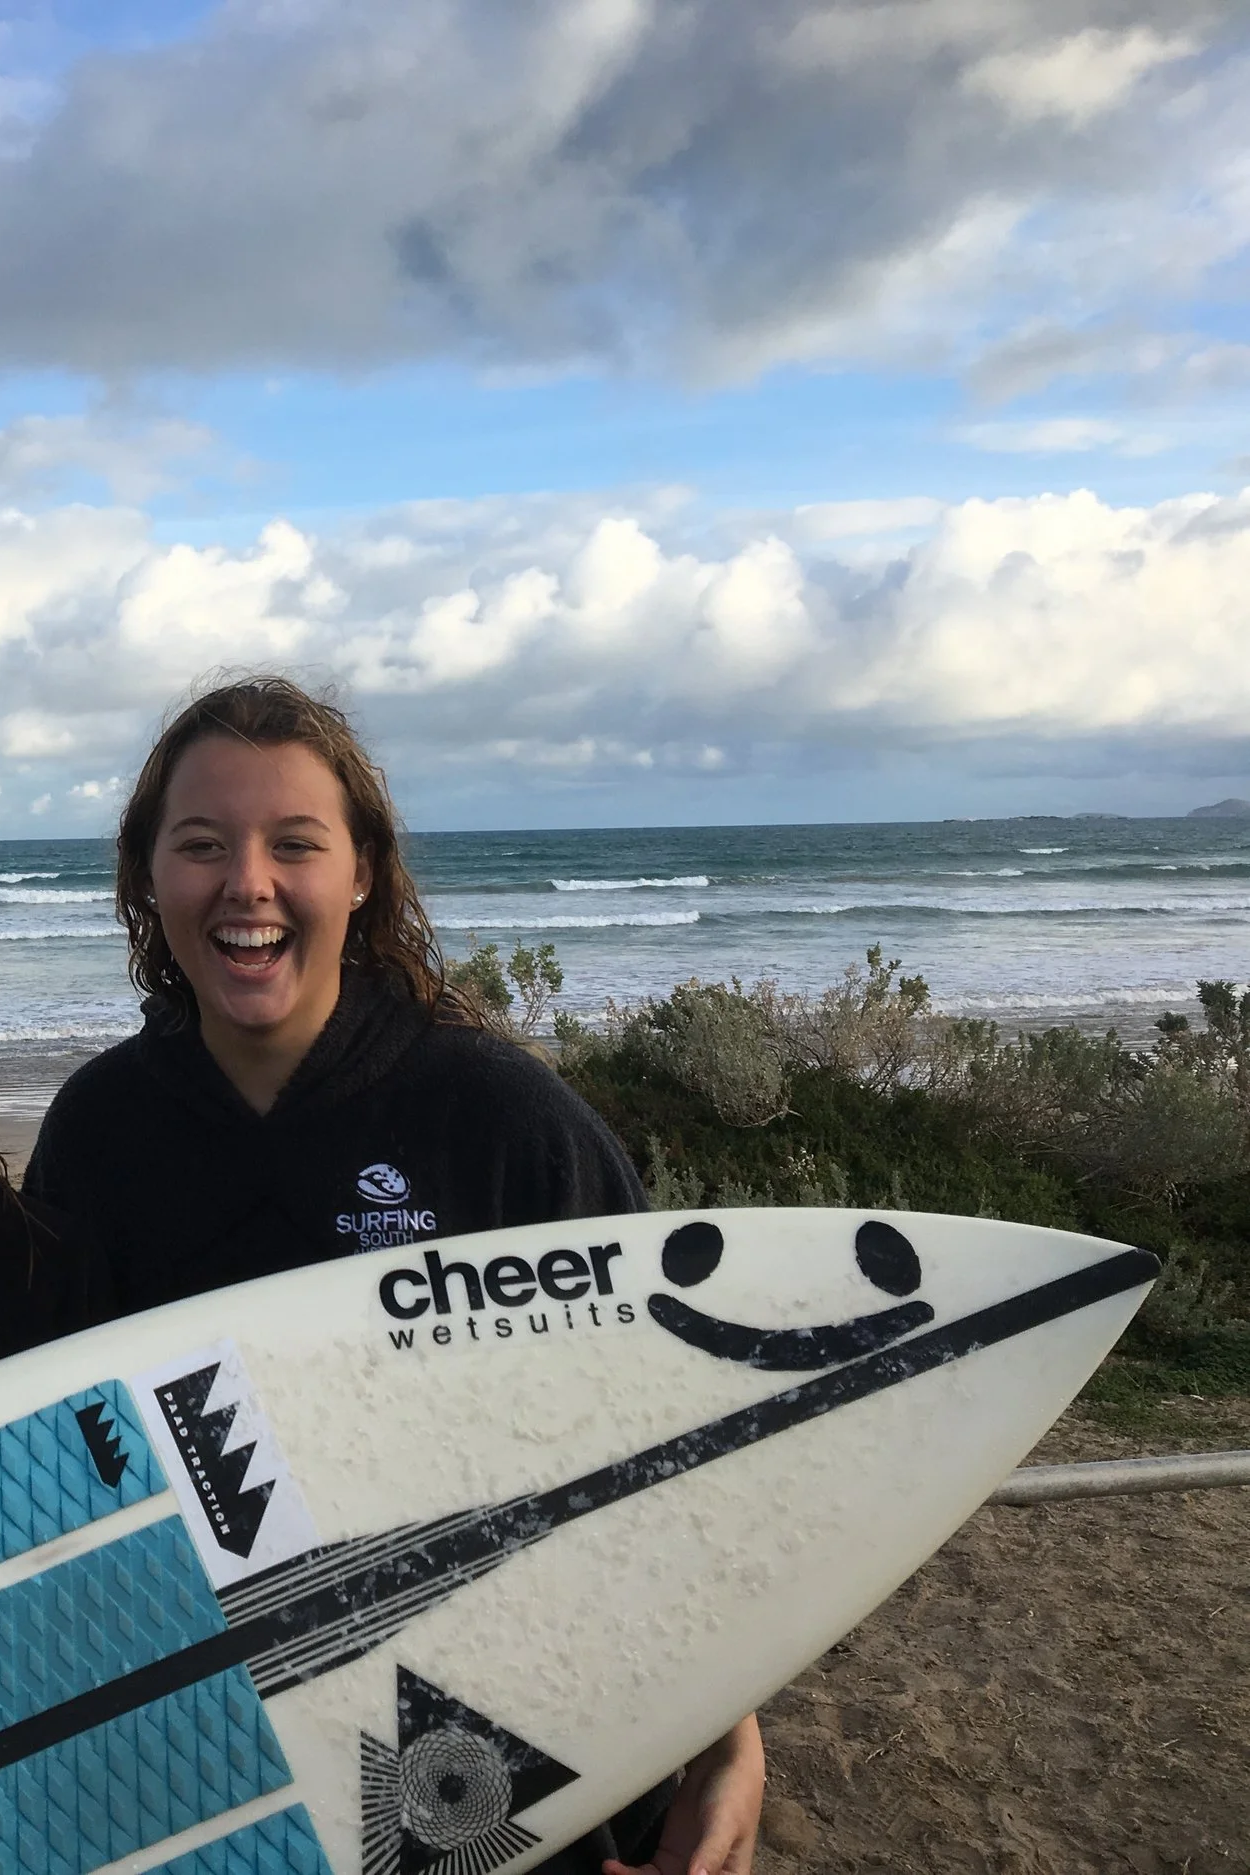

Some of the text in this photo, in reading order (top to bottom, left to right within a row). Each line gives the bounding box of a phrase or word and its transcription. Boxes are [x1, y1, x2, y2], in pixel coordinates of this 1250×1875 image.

[336, 1208, 436, 1234] SURFING
[359, 1230, 414, 1247] SOUTH
[379, 1241, 622, 1320] cheer
[388, 1302, 636, 1350] wetsuits
[163, 1391, 231, 1536] PAAD TRACTION
